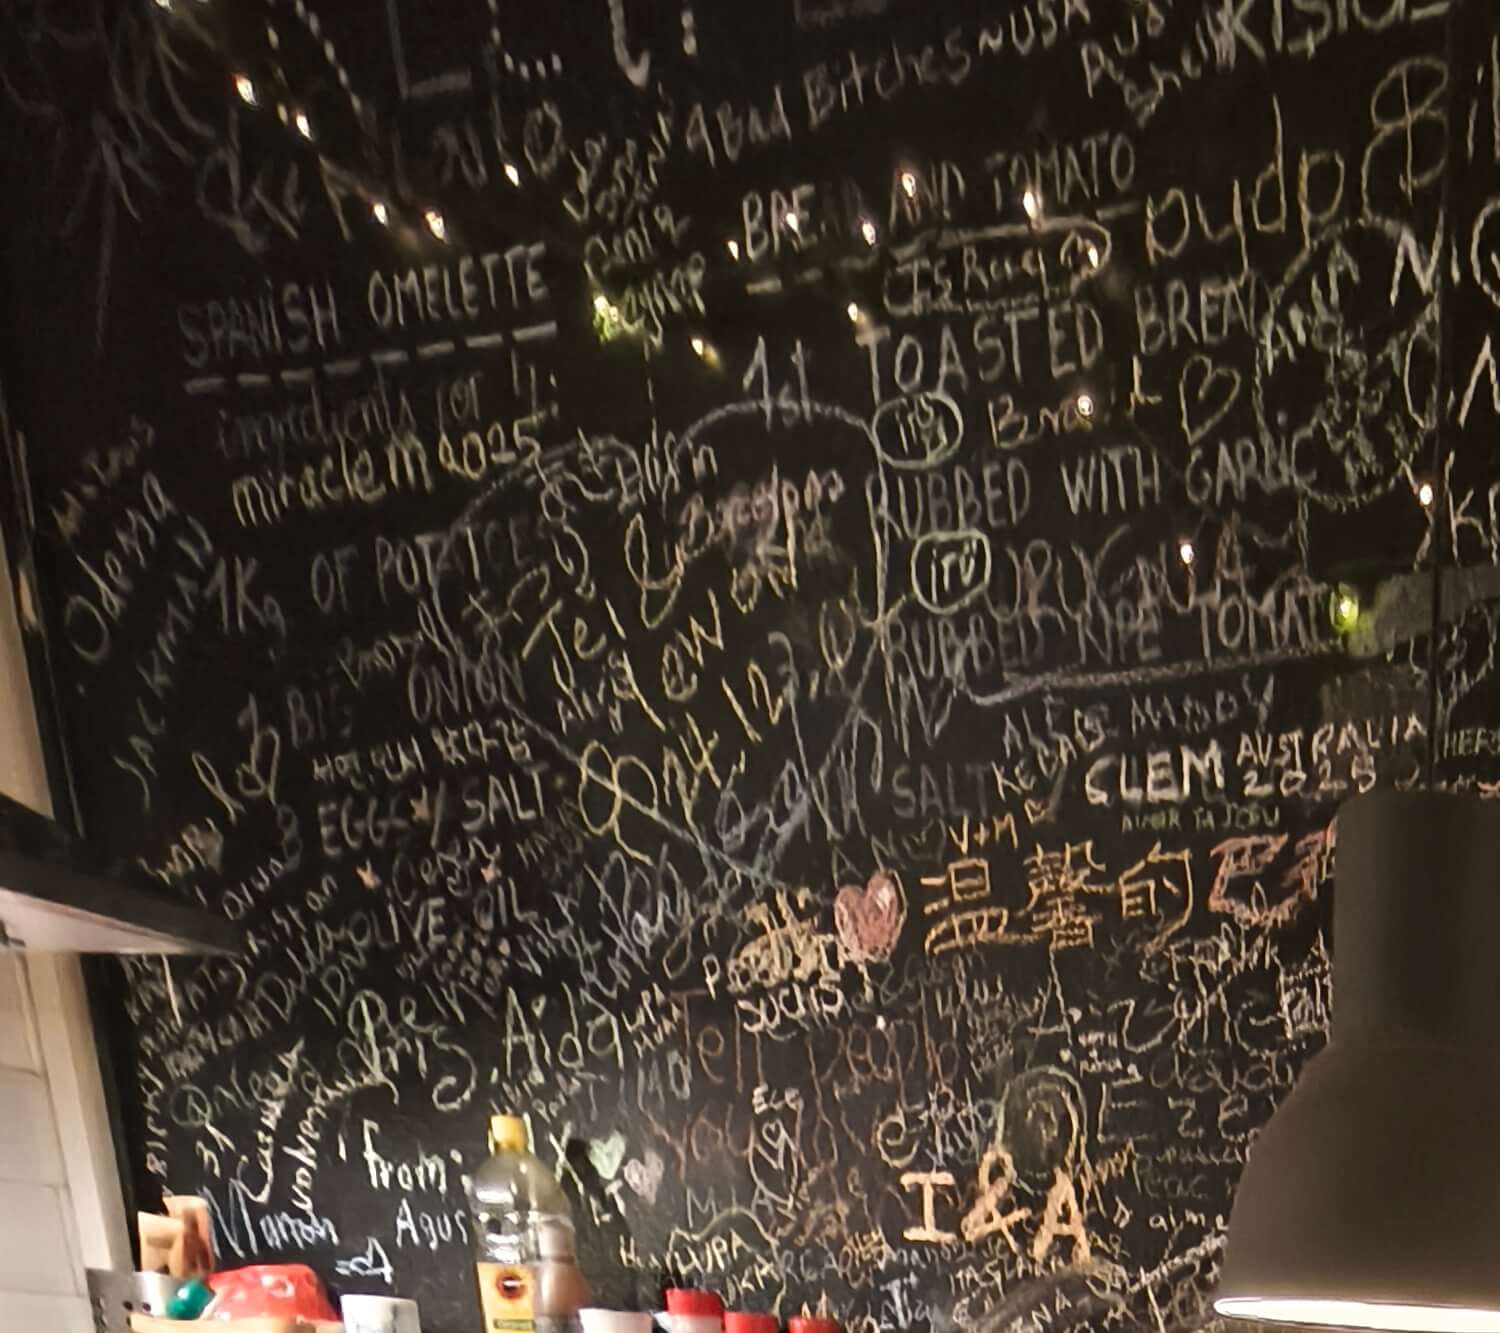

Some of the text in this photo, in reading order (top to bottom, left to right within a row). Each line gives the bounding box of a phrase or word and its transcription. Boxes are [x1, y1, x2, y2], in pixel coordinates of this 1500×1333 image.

[177, 243, 548, 368] SPANISH OMELETTE
[853, 300, 1105, 405] TOASTED
[867, 458, 1031, 541] RUBBED
[1060, 443, 1162, 515] WITH
[1084, 738, 1226, 806] CLEM
[1236, 712, 1427, 770] AUSTRALIA
[892, 758, 992, 819] SALT
[396, 1197, 469, 1252] Agus
